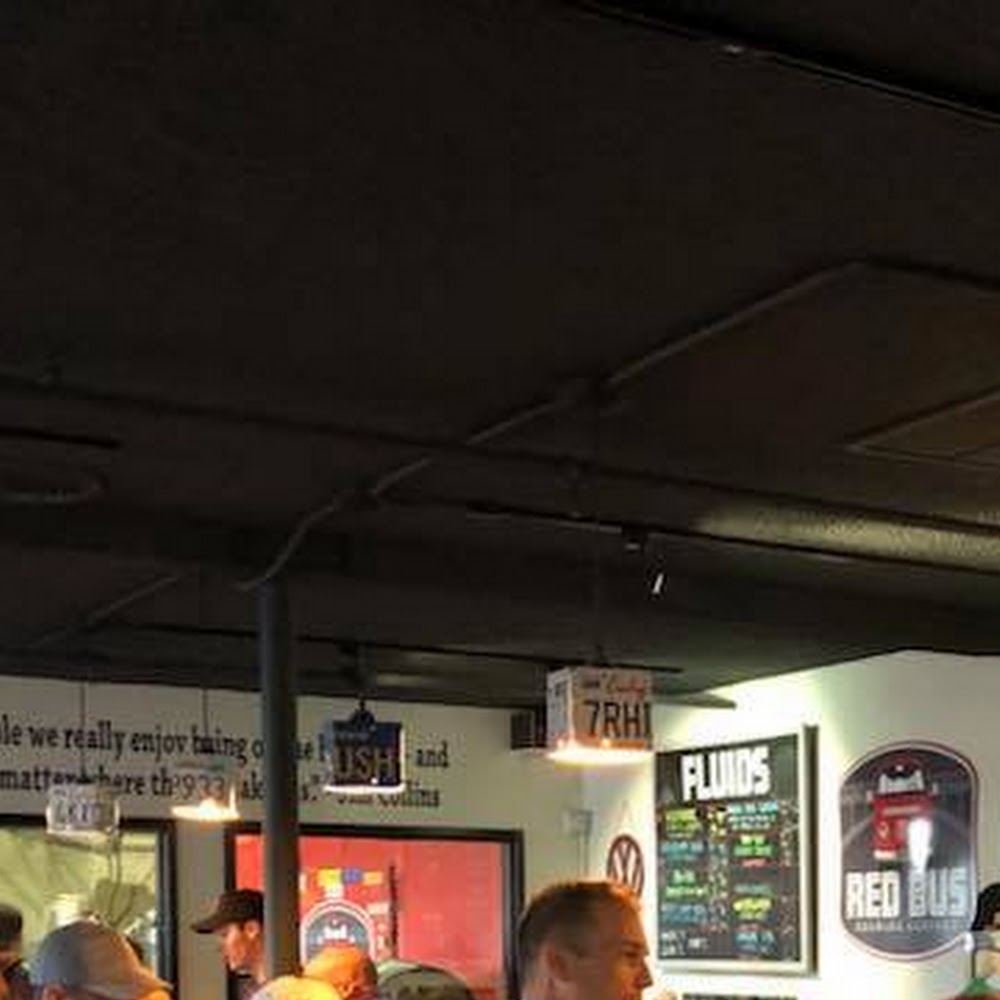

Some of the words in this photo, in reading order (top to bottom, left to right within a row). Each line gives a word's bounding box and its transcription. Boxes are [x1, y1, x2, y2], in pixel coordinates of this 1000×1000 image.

[28, 723, 58, 747] we
[63, 719, 126, 760] really
[131, 724, 187, 762] enjoy
[191, 724, 248, 767] bing
[416, 740, 449, 769] and
[90, 764, 146, 796] here
[681, 745, 771, 801] FLUIDS
[845, 870, 900, 920] RED
[908, 867, 968, 919] BUS
